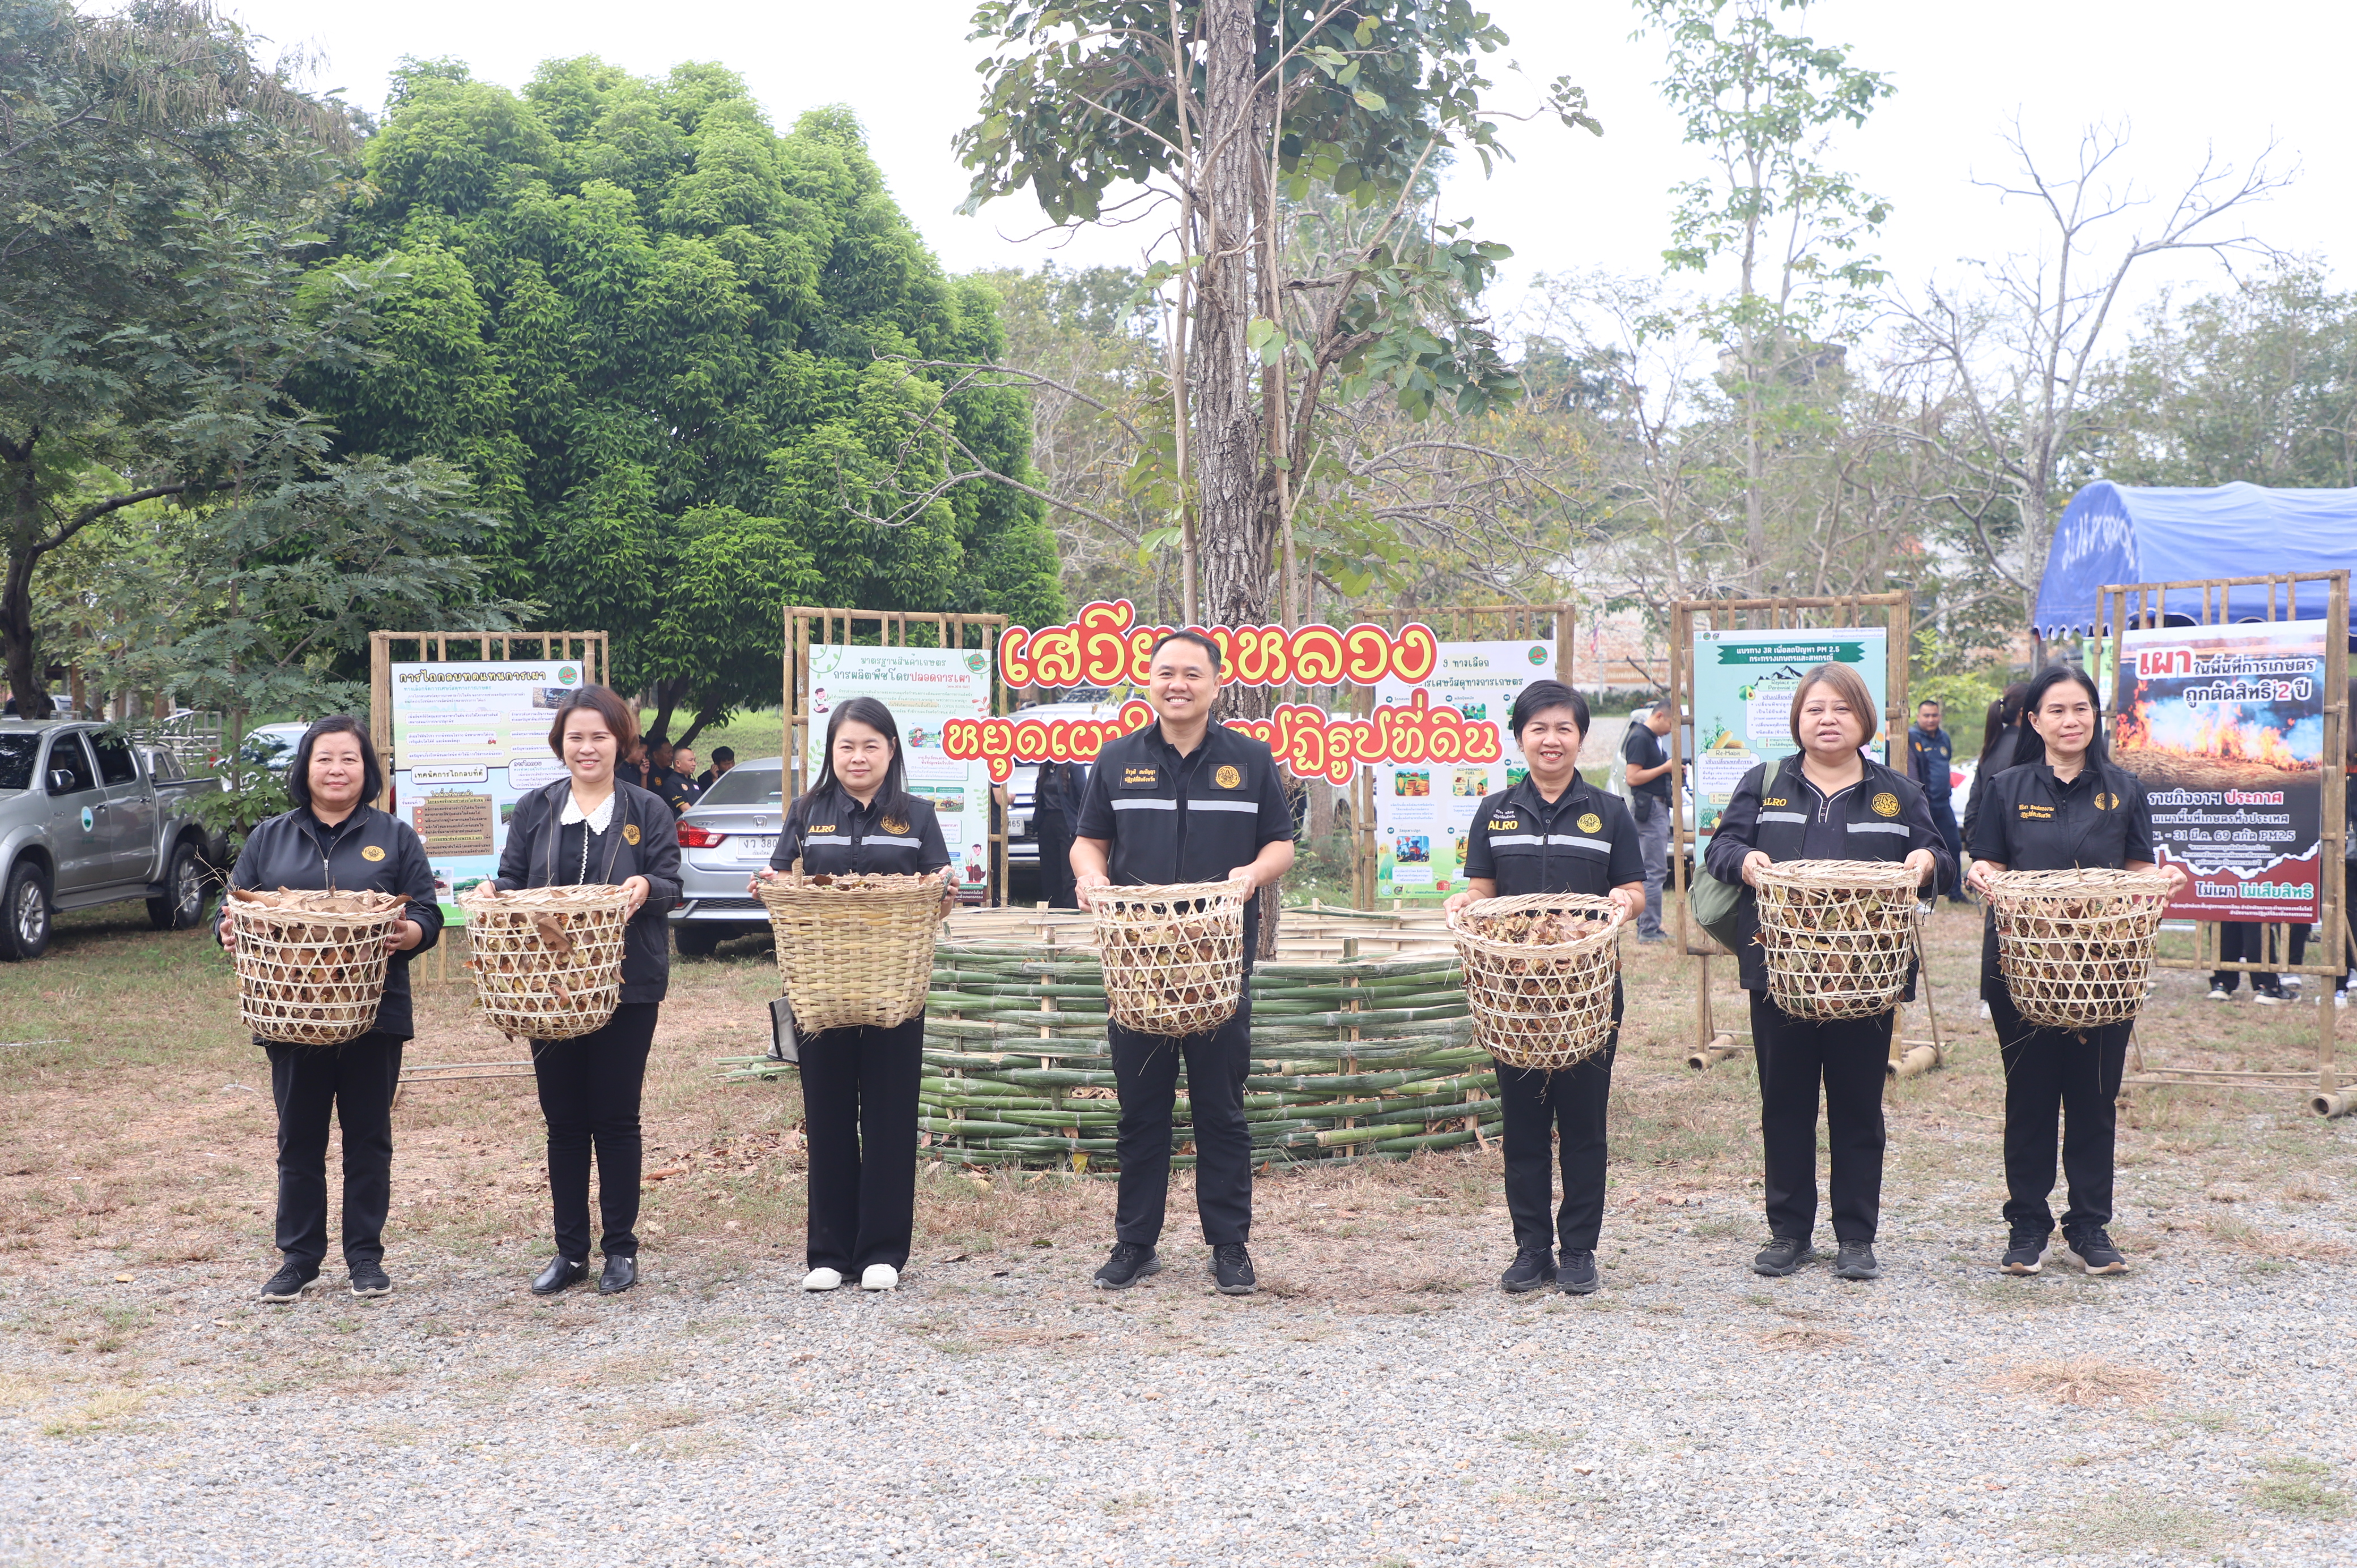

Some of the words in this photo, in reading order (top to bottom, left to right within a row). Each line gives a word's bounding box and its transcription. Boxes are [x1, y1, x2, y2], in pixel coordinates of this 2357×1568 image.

[1773, 645, 1815, 655] เพื่อลดปัญหา
[861, 653, 946, 667] มาตรฐานสินค้าเกษตร
[1452, 657, 1489, 668] ทางเลือก
[1749, 653, 1833, 662] กระทรวงเกษตรและสหกรณ์
[2139, 650, 2191, 675] เผา
[2194, 655, 2315, 675] ในพื้นที่การเกษตร
[399, 669, 546, 683] การไถกลบทดแทนการเผา
[833, 668, 971, 683] การผลิตพืชโดยปลอดการเผา
[2278, 684, 2289, 698] 2
[2295, 679, 2309, 698] ปี
[414, 767, 483, 778] เทคนิคการไถกลบที่ดี
[431, 788, 474, 797] ในพื้นที่นาแห้ง
[2225, 790, 2283, 804] ประกาศ
[1763, 798, 1787, 807] ALRO
[808, 825, 836, 833] ALRO
[1488, 820, 1518, 830] ALRO
[2173, 830, 2188, 841] 31
[2214, 830, 2231, 841] 69
[2232, 829, 2257, 841] สกัด
[743, 839, 756, 849] งว
[2197, 882, 2236, 897] ไม่เผา
[2240, 882, 2313, 899] ไม่เสียสิทธิ
